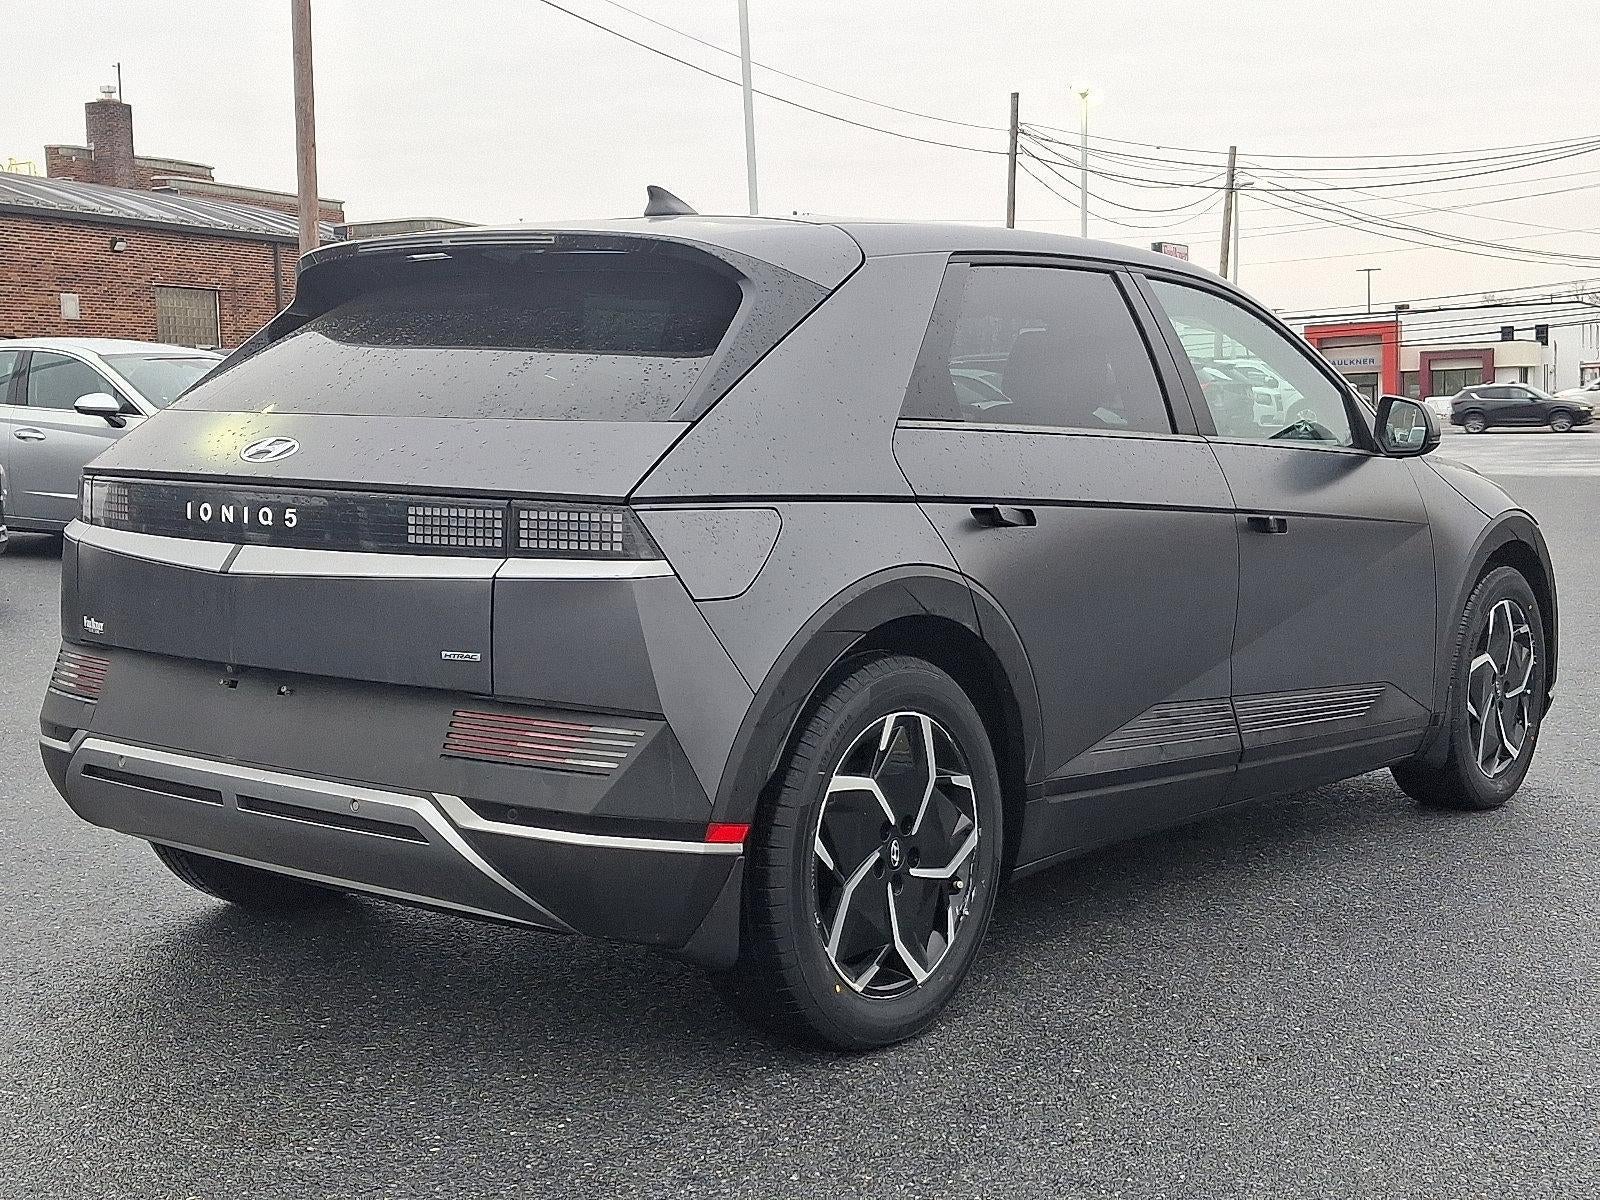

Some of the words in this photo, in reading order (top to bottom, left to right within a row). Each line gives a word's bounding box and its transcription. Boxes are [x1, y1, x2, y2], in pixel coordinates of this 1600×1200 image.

[1329, 358, 1375, 366] AULKNER
[186, 501, 274, 526] IONIQ
[284, 508, 298, 528] 5
[443, 652, 479, 660] HTRAC
